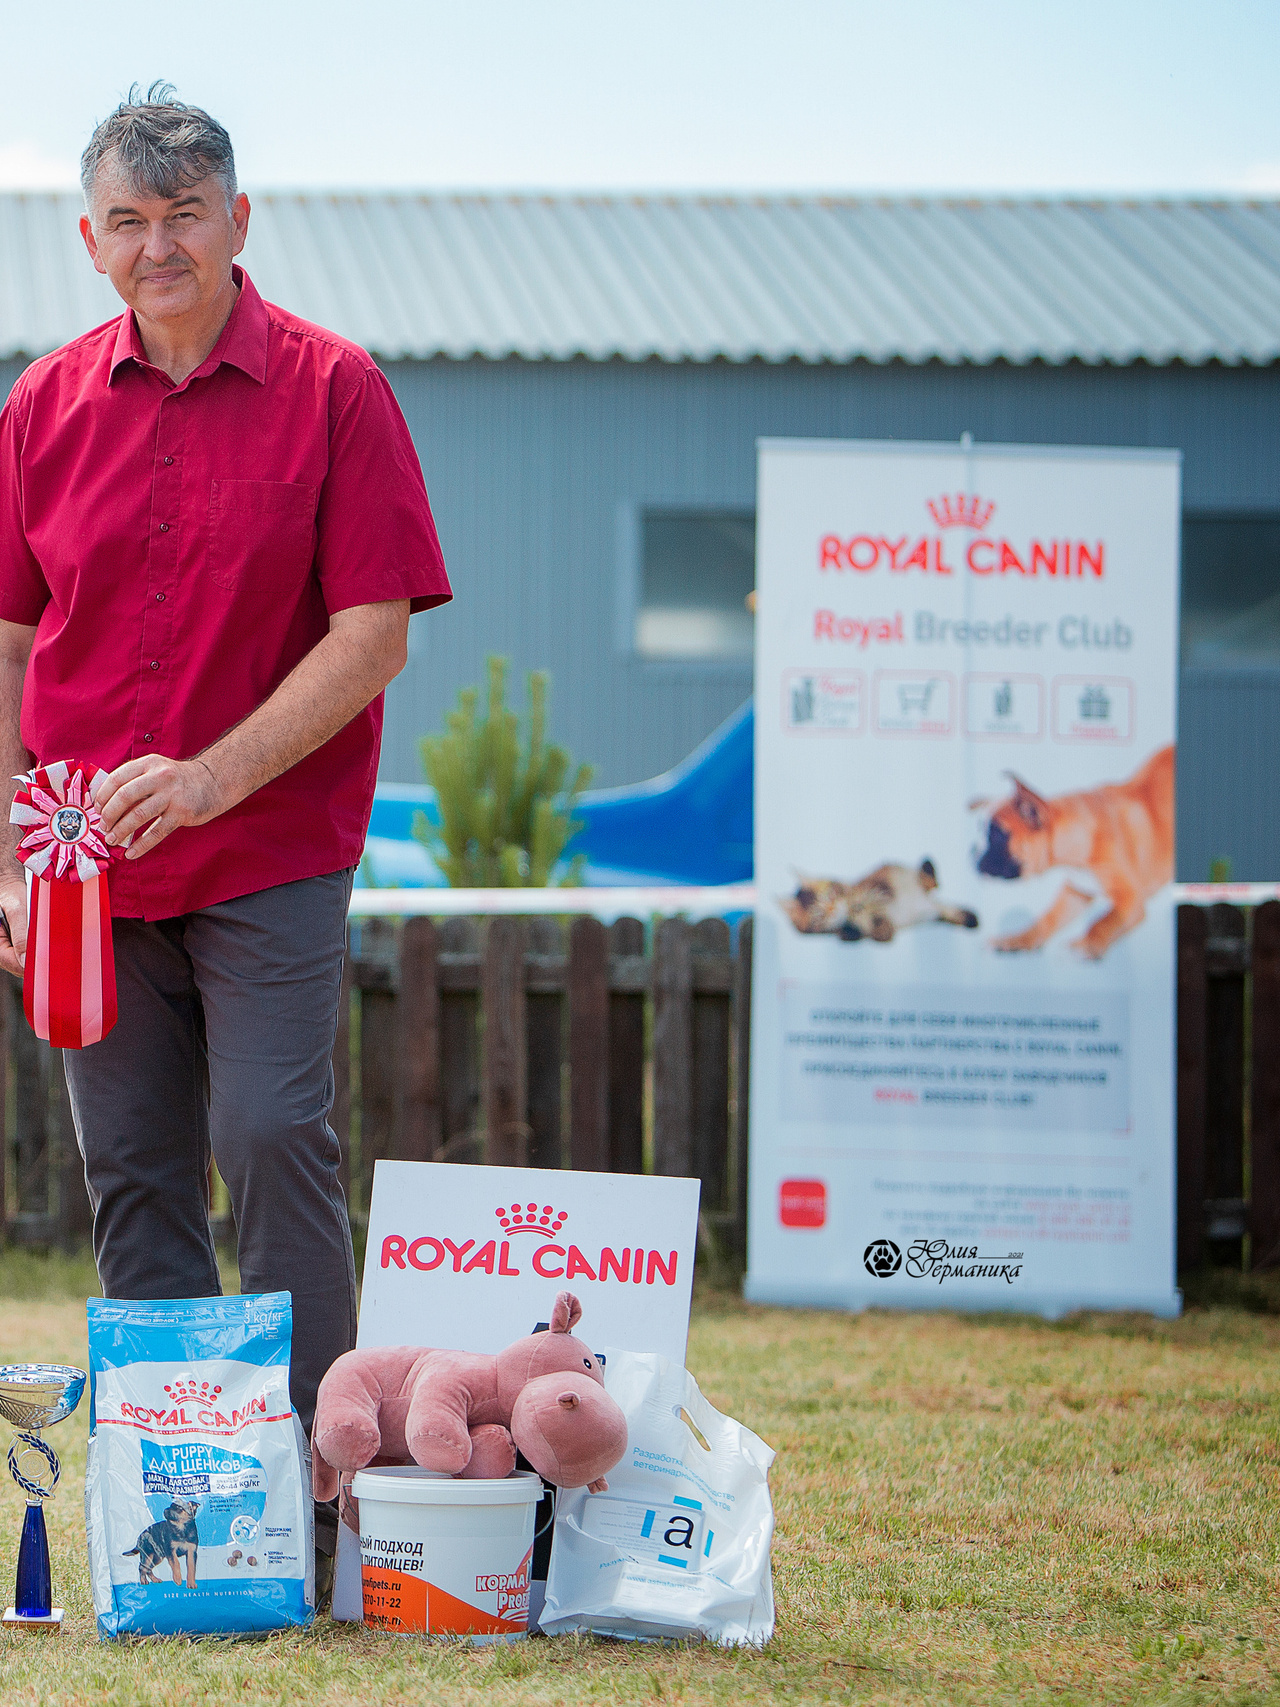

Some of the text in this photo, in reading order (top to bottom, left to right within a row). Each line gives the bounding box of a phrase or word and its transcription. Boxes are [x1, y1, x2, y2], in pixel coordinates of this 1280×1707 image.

[821, 535, 1104, 576] ROYAL CANIN
[814, 611, 1133, 648] Royal Breeder Club
[381, 1234, 678, 1285] ROYAL CANIN
[121, 1395, 267, 1427] ROYAL CANIN
[172, 1446, 213, 1460] PUPPY
[633, 1446, 684, 1468] Разработка
[149, 1457, 241, 1474] ДЛЯ ЩЕНКОВ
[147, 1474, 163, 1482] MAXI
[183, 1477, 206, 1486] СОБАК
[176, 1485, 209, 1495] РАЗМЕРОВ
[664, 1515, 695, 1549] a
[374, 1539, 424, 1556] ПОДХОД
[365, 1554, 424, 1572] ПИТОМЦЕВ!
[476, 1574, 526, 1592] КОРМА
